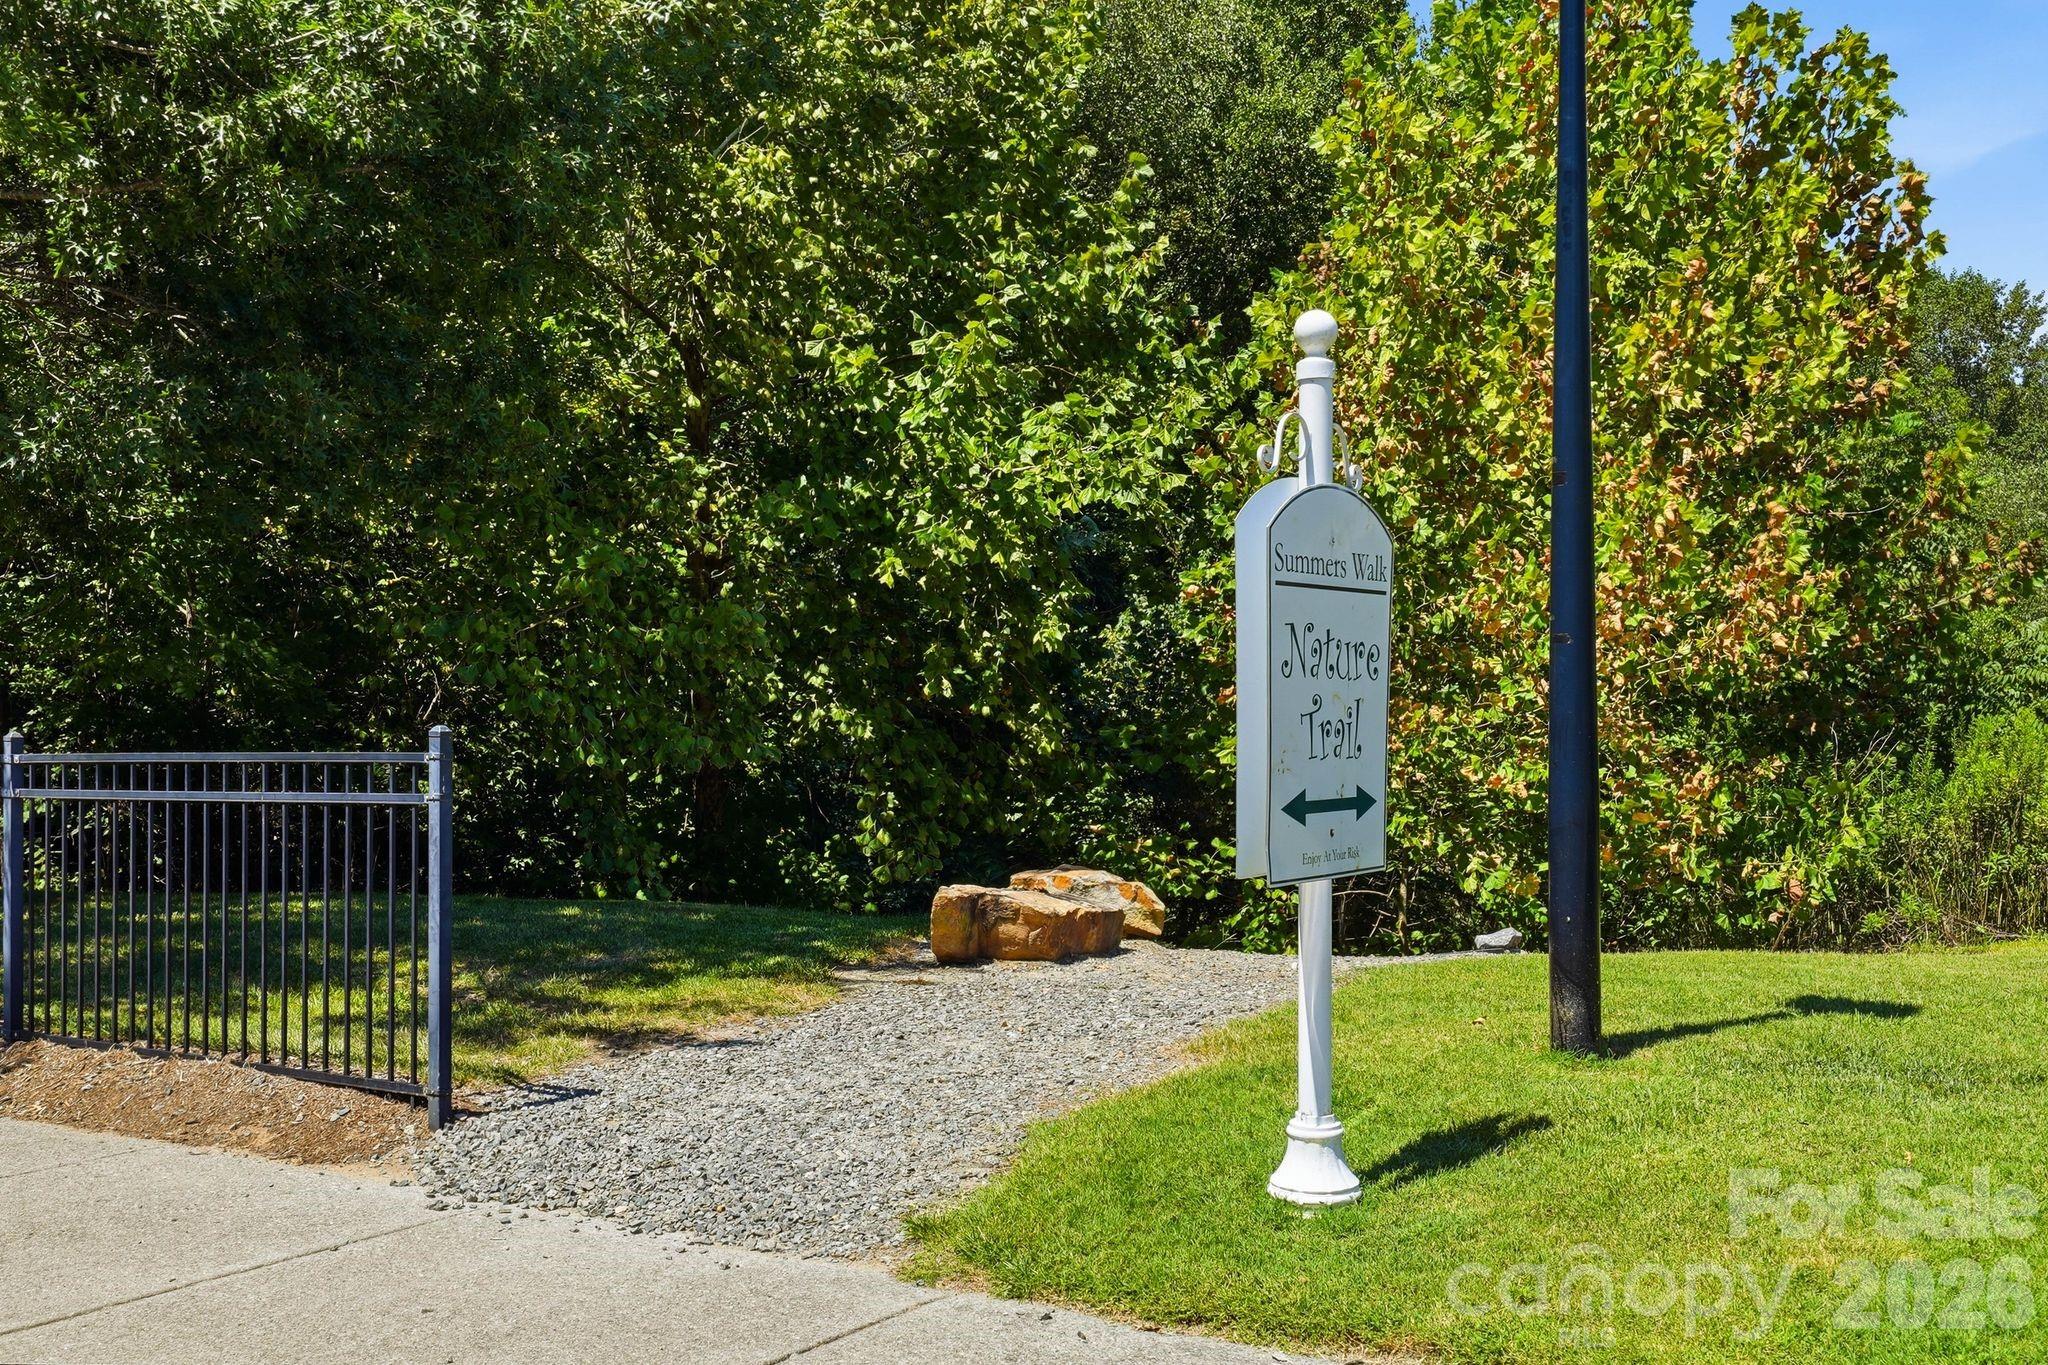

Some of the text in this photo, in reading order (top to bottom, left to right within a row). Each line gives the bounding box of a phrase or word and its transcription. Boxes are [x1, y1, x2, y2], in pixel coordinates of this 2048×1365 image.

[1274, 542, 1388, 583] Summers Walk
[1281, 622, 1380, 682] Nature
[1300, 693, 1362, 761] Trail
[1302, 845, 1360, 868] Enjoy At Your Risk
